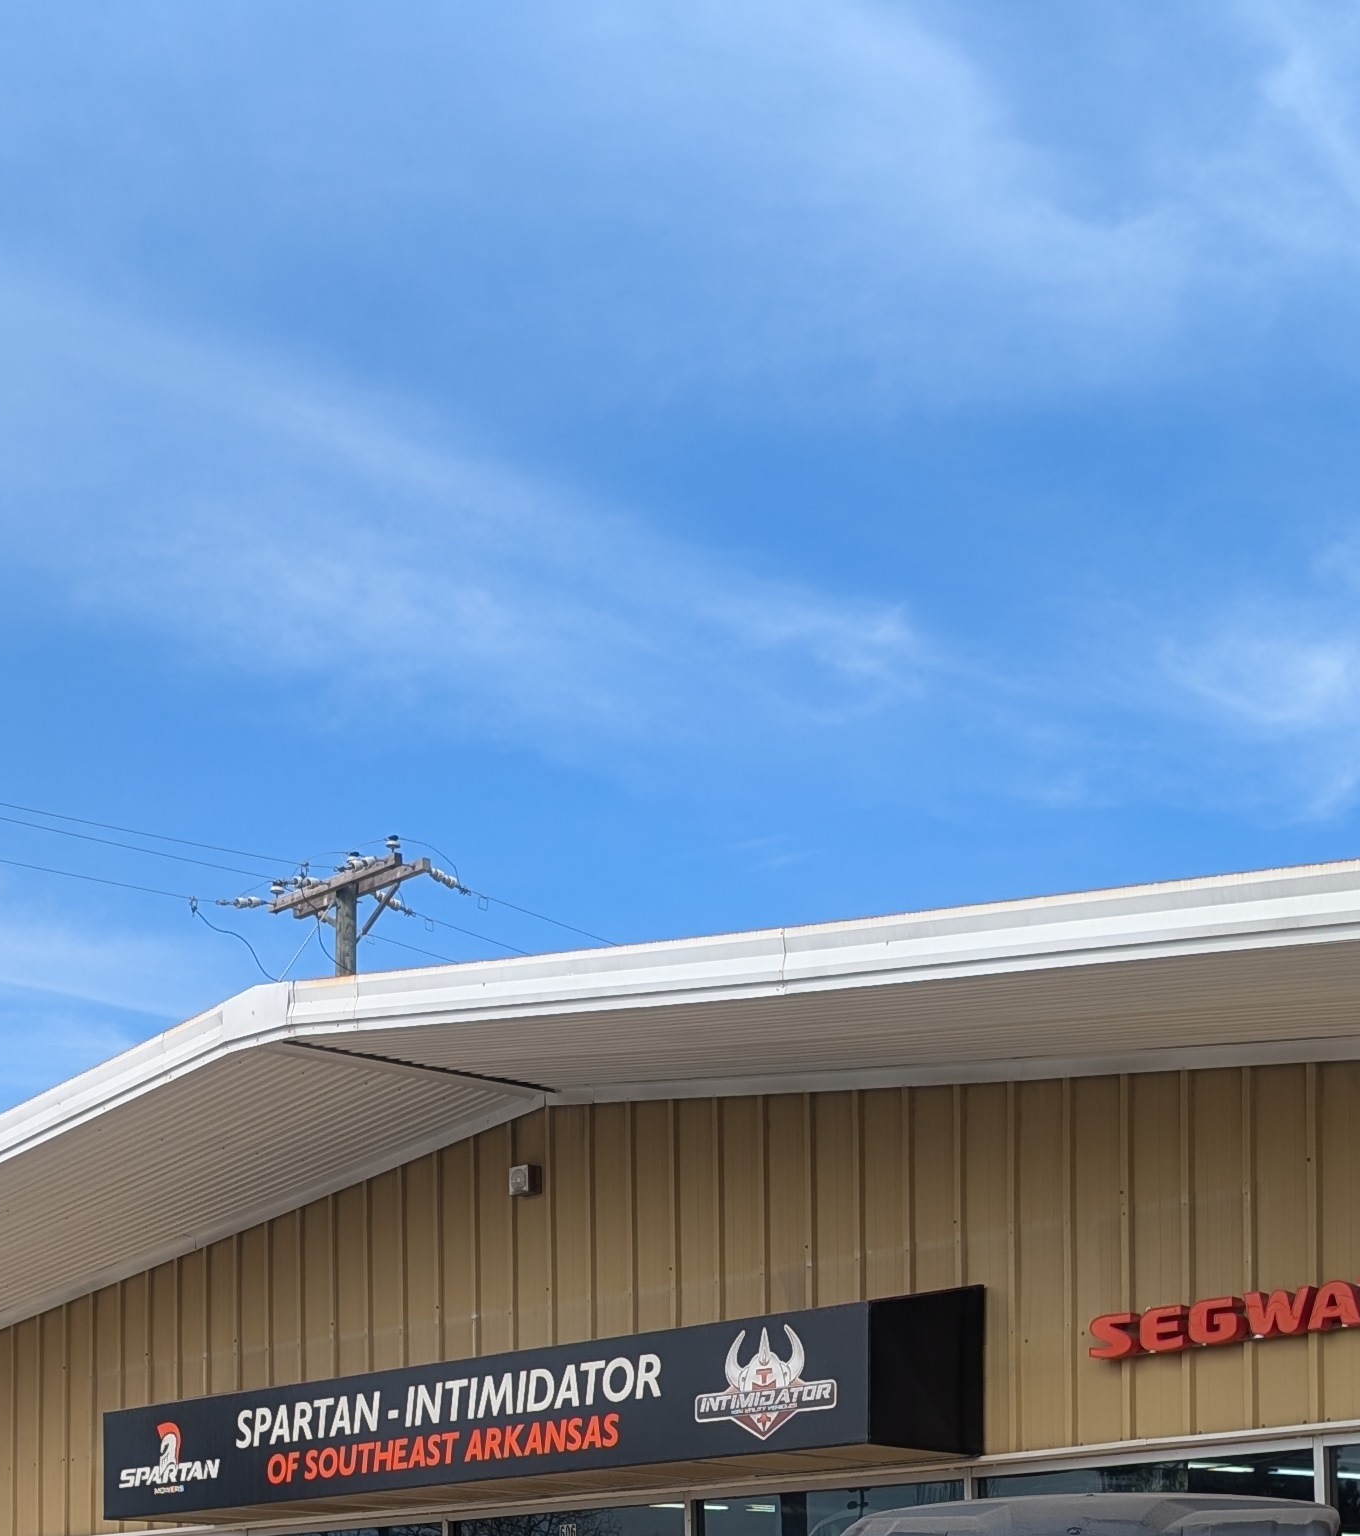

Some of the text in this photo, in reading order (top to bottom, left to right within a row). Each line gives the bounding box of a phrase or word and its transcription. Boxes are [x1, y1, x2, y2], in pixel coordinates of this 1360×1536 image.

[236, 1392, 381, 1449] SPARTAN
[404, 1354, 662, 1428] INTIMIDATOR
[699, 1383, 833, 1413] INTIMIDATOR
[118, 1458, 221, 1489] SPARTAN
[267, 1413, 620, 1485] OF SOUTHEAST ARKANSAS
